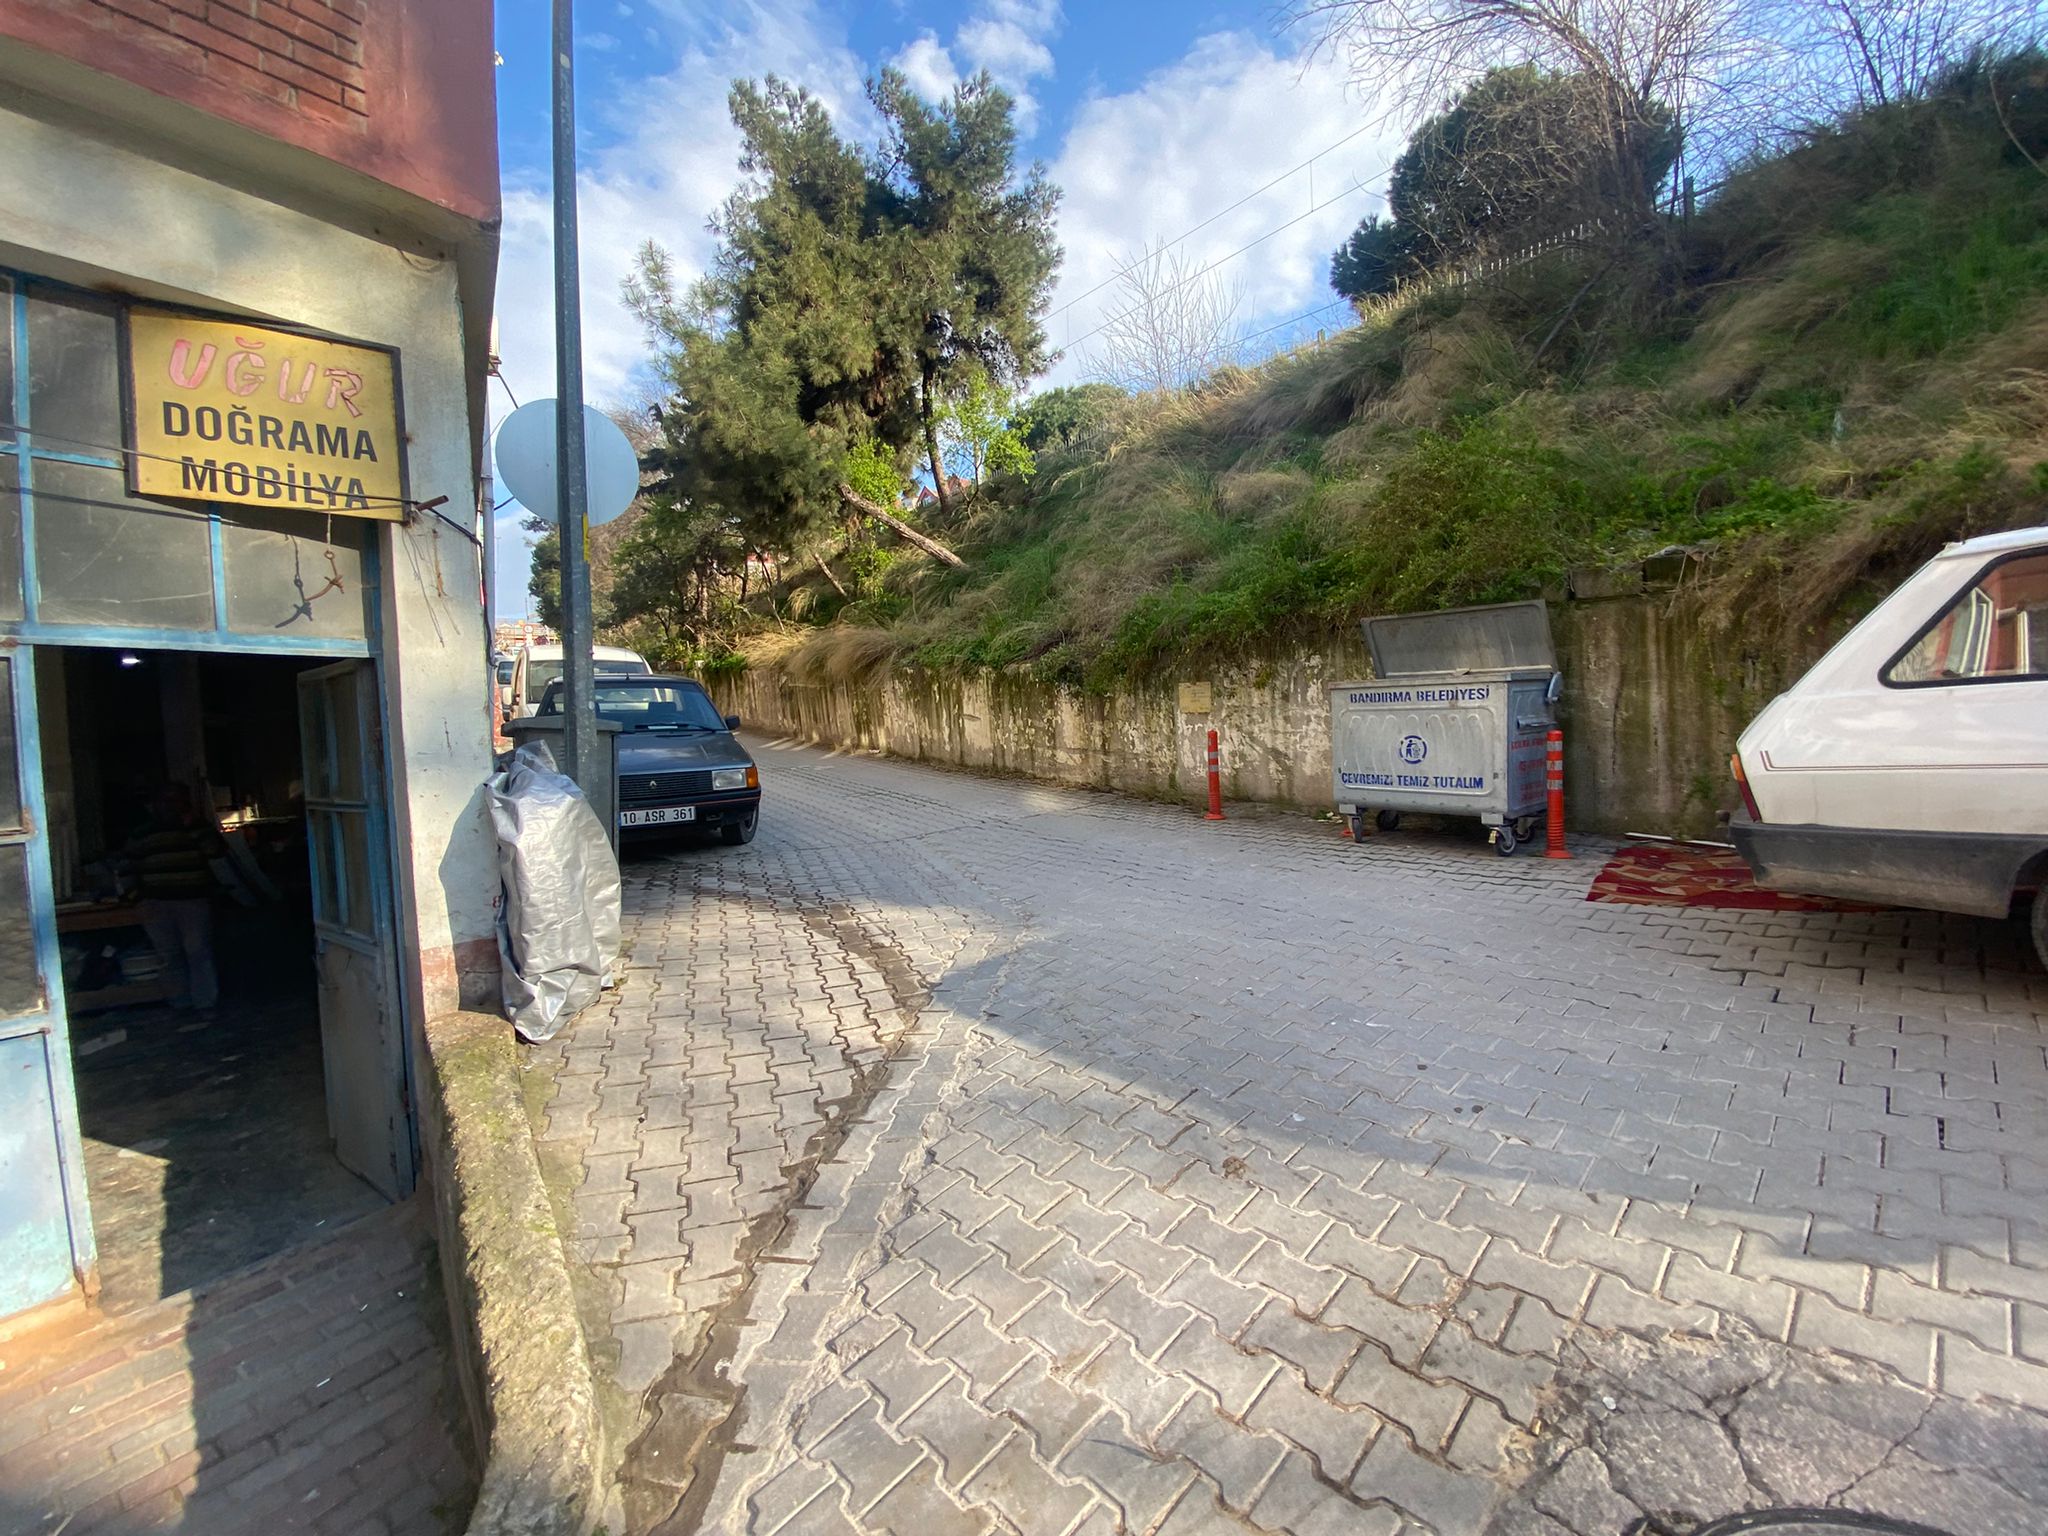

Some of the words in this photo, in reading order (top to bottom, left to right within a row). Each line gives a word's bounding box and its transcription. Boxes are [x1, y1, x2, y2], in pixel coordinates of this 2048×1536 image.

[168, 336, 363, 418] UĞUR
[162, 401, 378, 463] DOĞRAMA
[181, 456, 370, 510] MOBİLYA
[1350, 691, 1412, 704] BANDIRMA
[1416, 685, 1490, 702] BELEDİYESİ
[1433, 776, 1484, 789] TUTALIM
[623, 812, 637, 825] 10
[644, 810, 666, 823] ASR
[672, 807, 693, 820] 361
